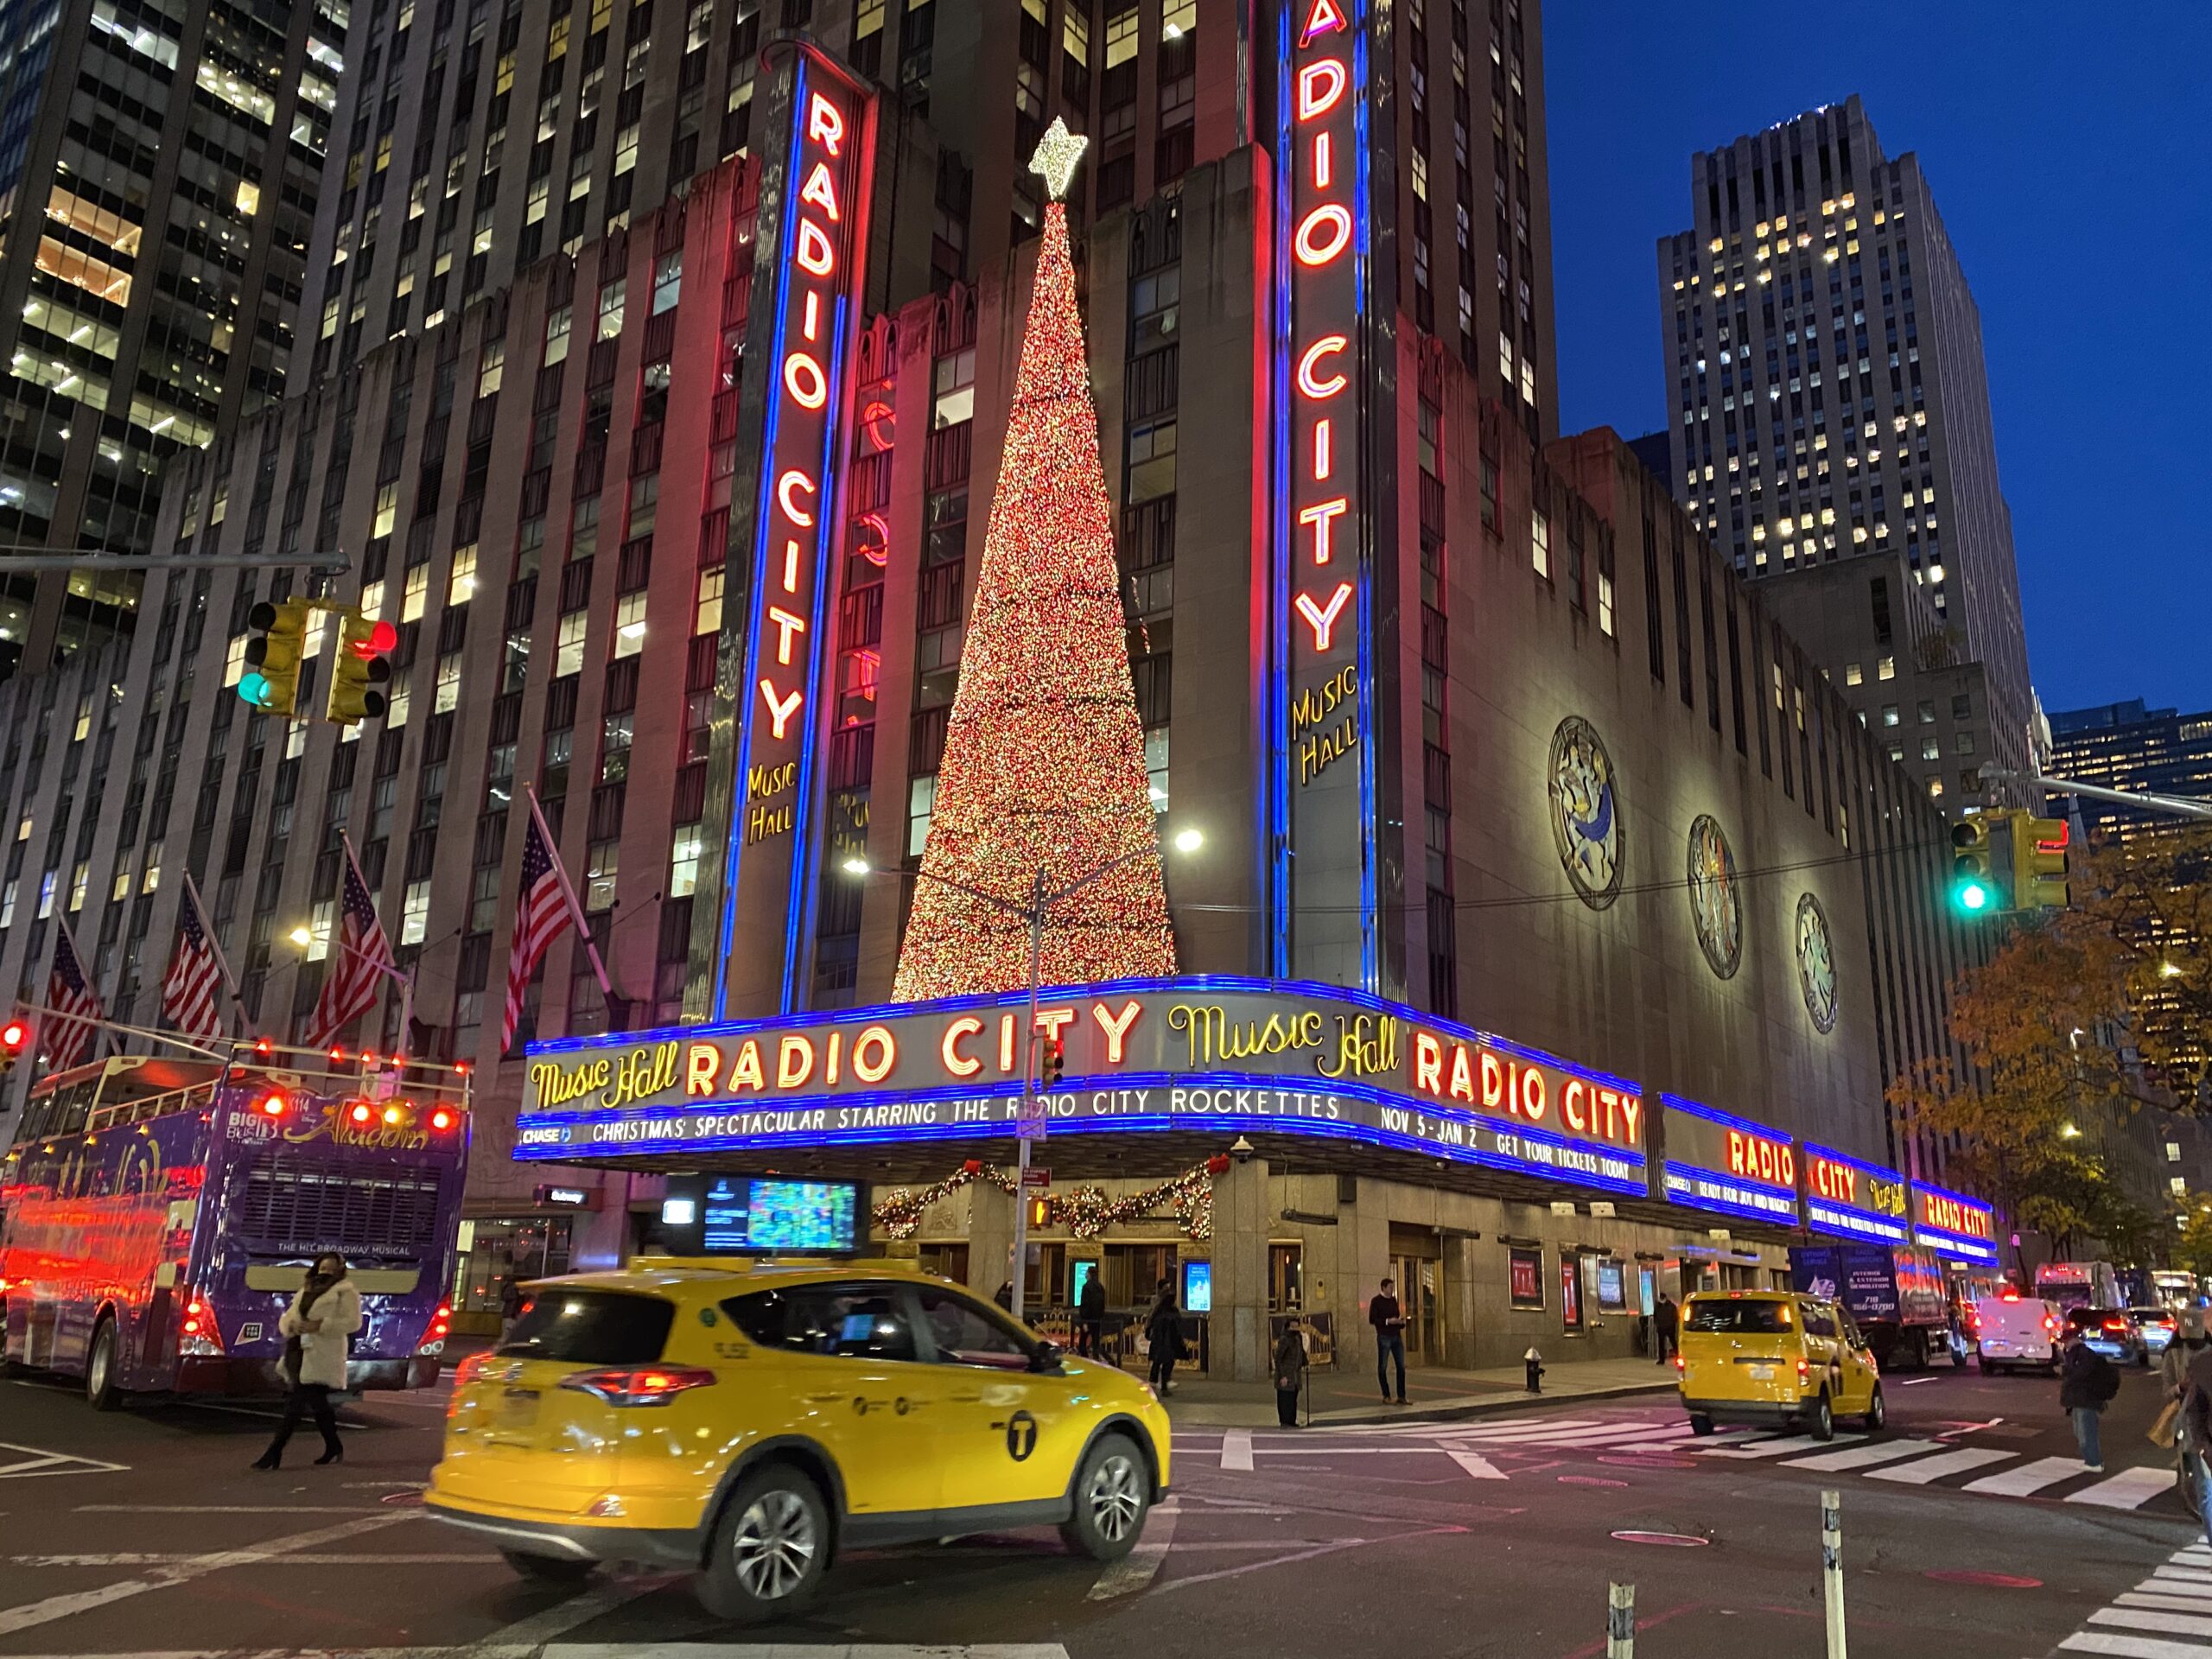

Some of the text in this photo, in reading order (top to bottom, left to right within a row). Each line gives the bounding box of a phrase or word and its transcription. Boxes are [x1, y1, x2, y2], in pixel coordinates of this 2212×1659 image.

[759, 91, 844, 741] RADIO CITY
[1294, 335, 1352, 652] CITY
[1300, 718, 1357, 785] HALL
[749, 804, 792, 844] HALL
[531, 1040, 679, 1109] Music Hall
[687, 999, 1143, 1097] RADIO CITY
[1168, 1005, 1401, 1078] Music Hall
[228, 1112, 257, 1127] BIG
[695, 1110, 826, 1137] SPECTACULAR
[837, 1102, 937, 1128] STARRING
[953, 1098, 989, 1122] THE
[1006, 1094, 1076, 1120] RDIO
[1092, 1090, 1149, 1116] CITY
[1171, 1089, 1338, 1120] ROCKETTES
[1415, 1031, 1639, 1145] RADIO CITY
[226, 1126, 255, 1139] BUS
[523, 1128, 560, 1143] CHASE
[1381, 1106, 1409, 1134] NOV
[1469, 1128, 1477, 1148] 2
[1497, 1133, 1518, 1156] GET
[1523, 1140, 1552, 1164] YOUR
[1557, 1147, 1597, 1173] TICKETS
[1600, 1157, 1629, 1181] TODAY
[1699, 1180, 1720, 1199] READY
[1723, 1186, 1738, 1203] FOR
[1729, 1130, 1855, 1203] RADIO CITY
[1926, 1193, 1986, 1237] RADIO CITY
[277, 1243, 410, 1255] THE HIT BROADWAY MUSICAL
